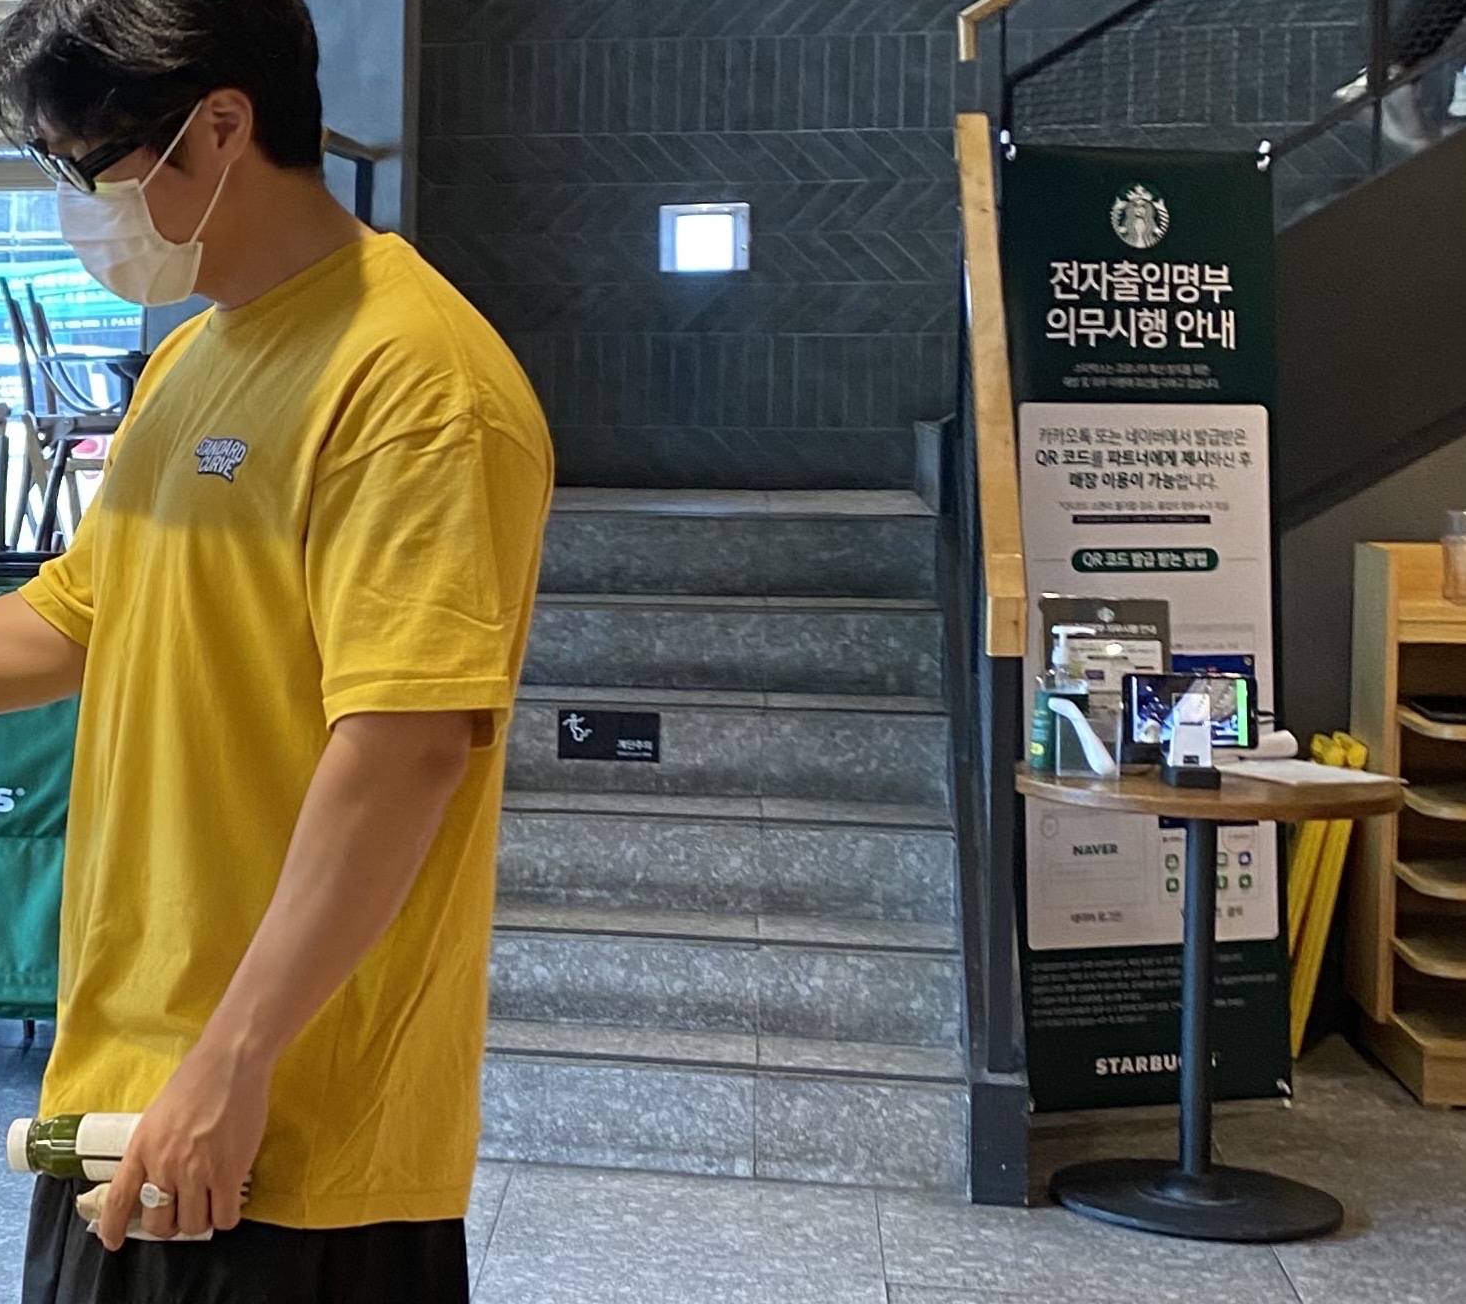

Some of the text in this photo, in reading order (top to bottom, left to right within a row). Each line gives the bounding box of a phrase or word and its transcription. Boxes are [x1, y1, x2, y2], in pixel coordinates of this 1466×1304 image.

[1048, 259, 1234, 305] 전자출입명부
[1045, 306, 1237, 351] 의무시행 안내
[1094, 427, 1123, 445] 또는
[1125, 428, 1192, 446] 네이버에서
[198, 454, 235, 480] CURVE
[1035, 449, 1253, 469] QR 코드를 파트너에게 제시하신 후
[1068, 471, 1099, 489] 매장
[1101, 472, 1144, 490] 이용이
[1081, 551, 1104, 569] QR
[1104, 552, 1130, 568] 코드
[1072, 843, 1119, 857] NAVER
[1095, 1052, 1220, 1076] STARBU
